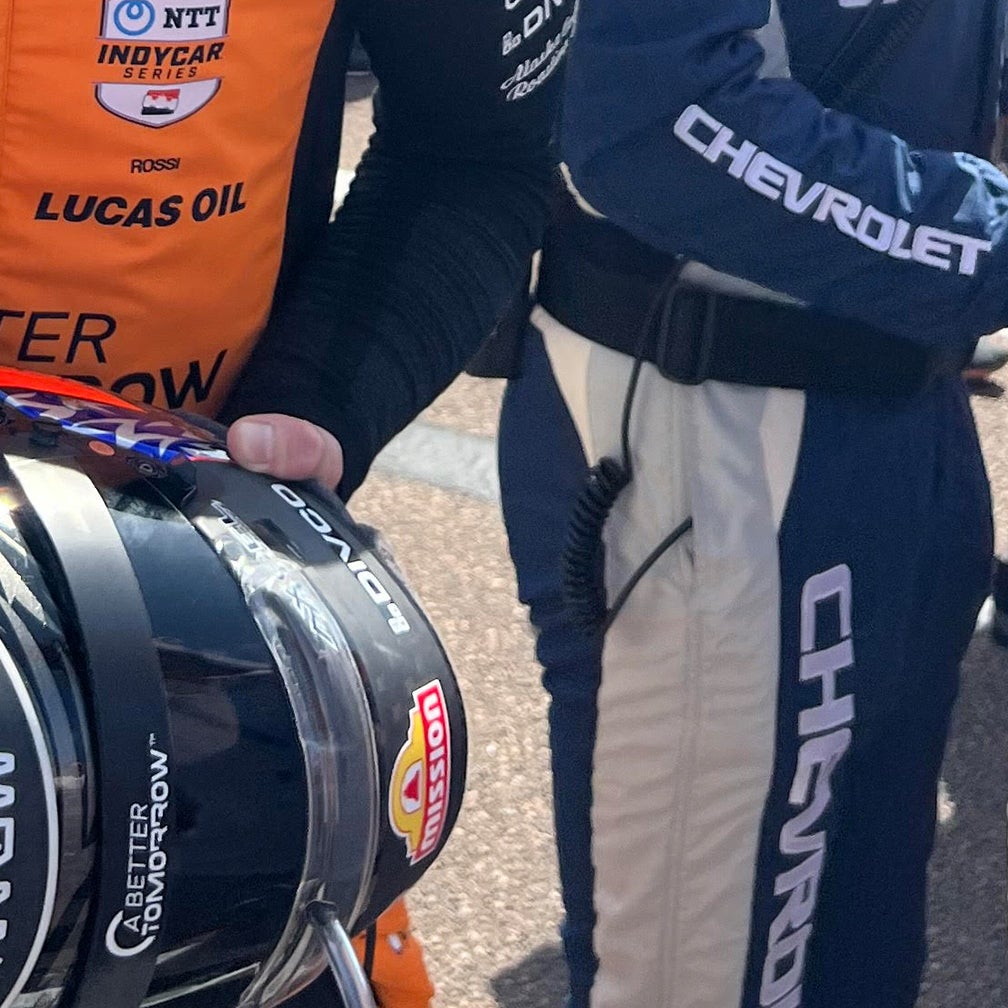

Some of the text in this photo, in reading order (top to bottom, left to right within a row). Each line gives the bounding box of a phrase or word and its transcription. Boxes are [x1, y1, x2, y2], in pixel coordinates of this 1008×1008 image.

[162, 6, 220, 29] NTT
[97, 42, 223, 65] INDYCAR
[123, 66, 198, 79] SERIES
[130, 158, 181, 173] ROSSI
[34, 183, 247, 228] LUCAS OIL
[674, 104, 992, 276] CHEVROLET
[271, 483, 393, 605] DIVCO
[759, 563, 854, 1008] CHEVRO
[123, 802, 149, 932] A BETTER
